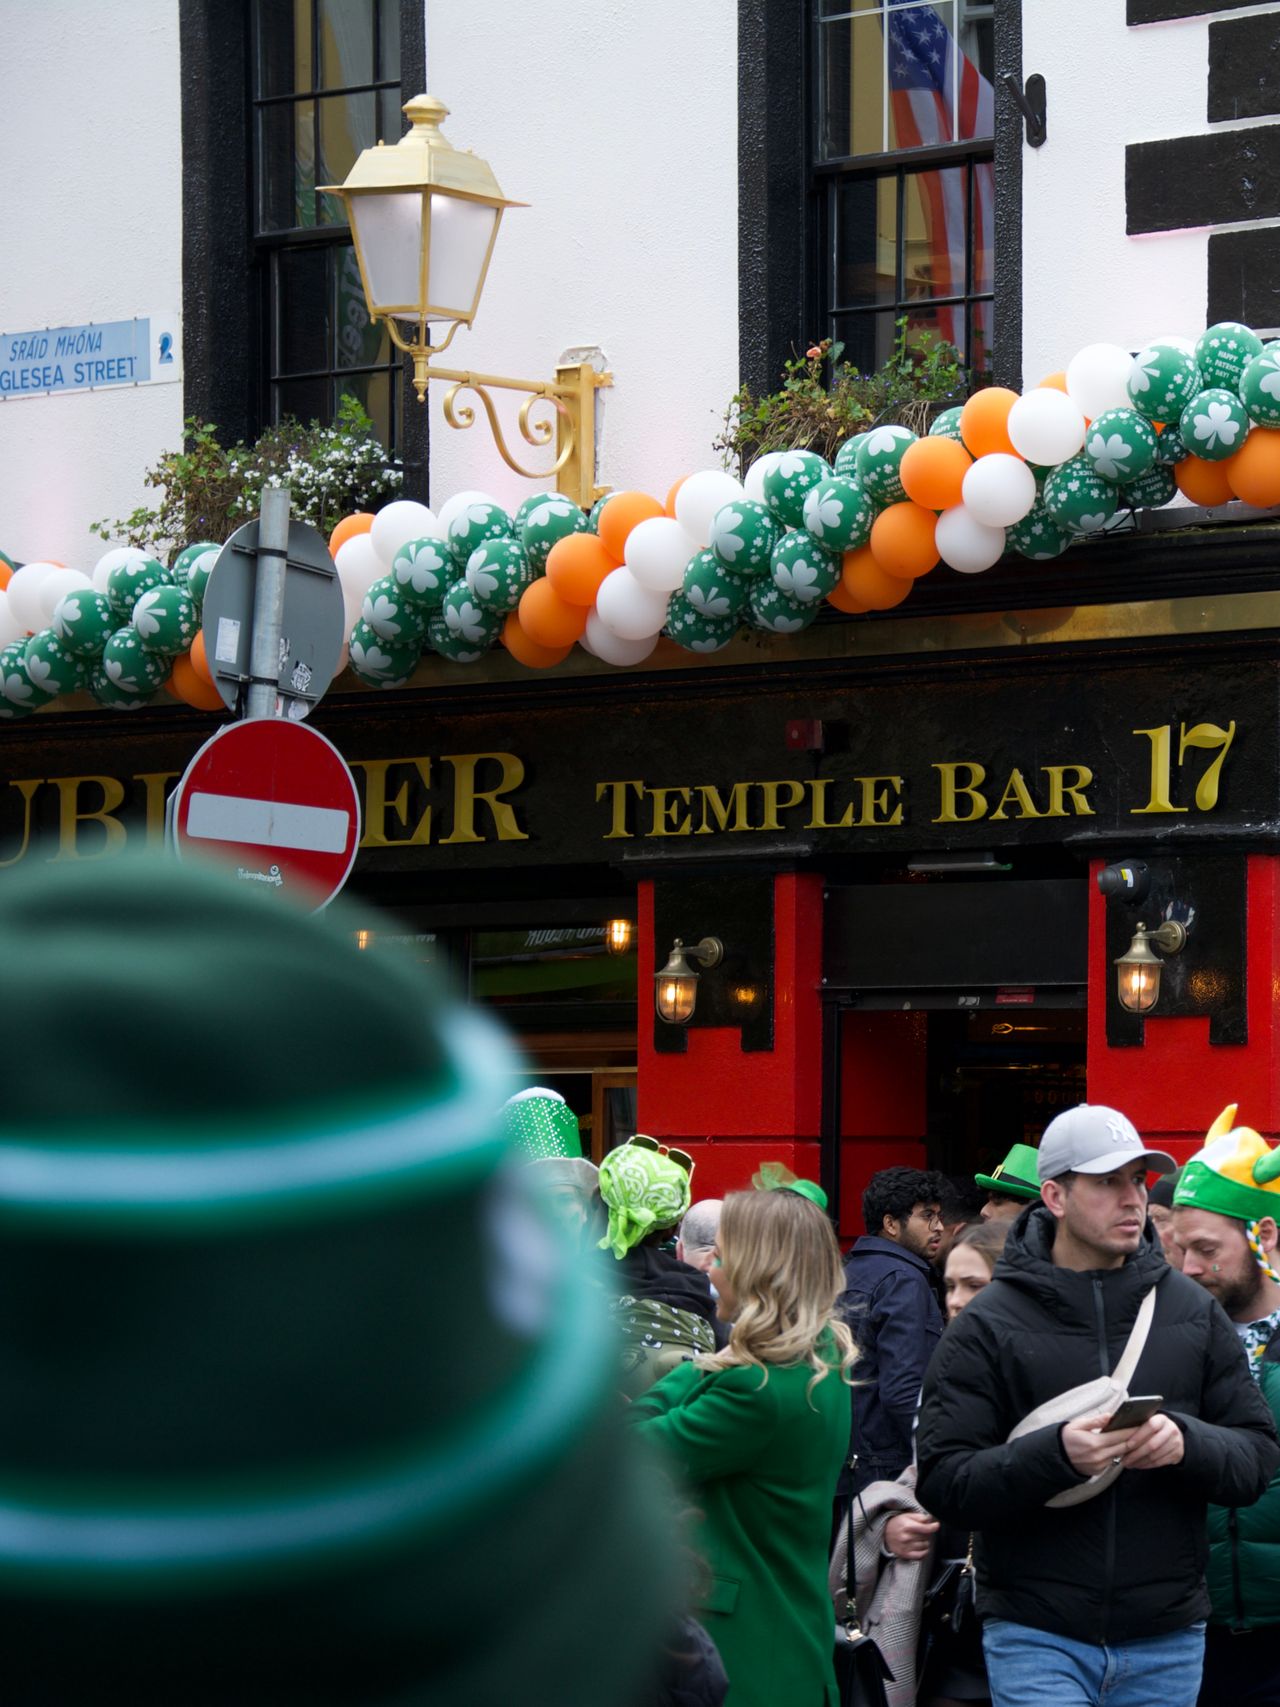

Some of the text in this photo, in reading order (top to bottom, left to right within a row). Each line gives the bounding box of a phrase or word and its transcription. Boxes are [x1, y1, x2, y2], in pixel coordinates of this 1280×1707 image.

[9, 329, 103, 362] SRÁID MHÓNA
[1217, 350, 1240, 363] HAPPY
[0, 357, 137, 392] GLESEA STREET
[1146, 481, 1164, 493] HAPPY
[765, 533, 774, 555] HAPPY
[595, 719, 1237, 839] TEMPLE BAR 17
